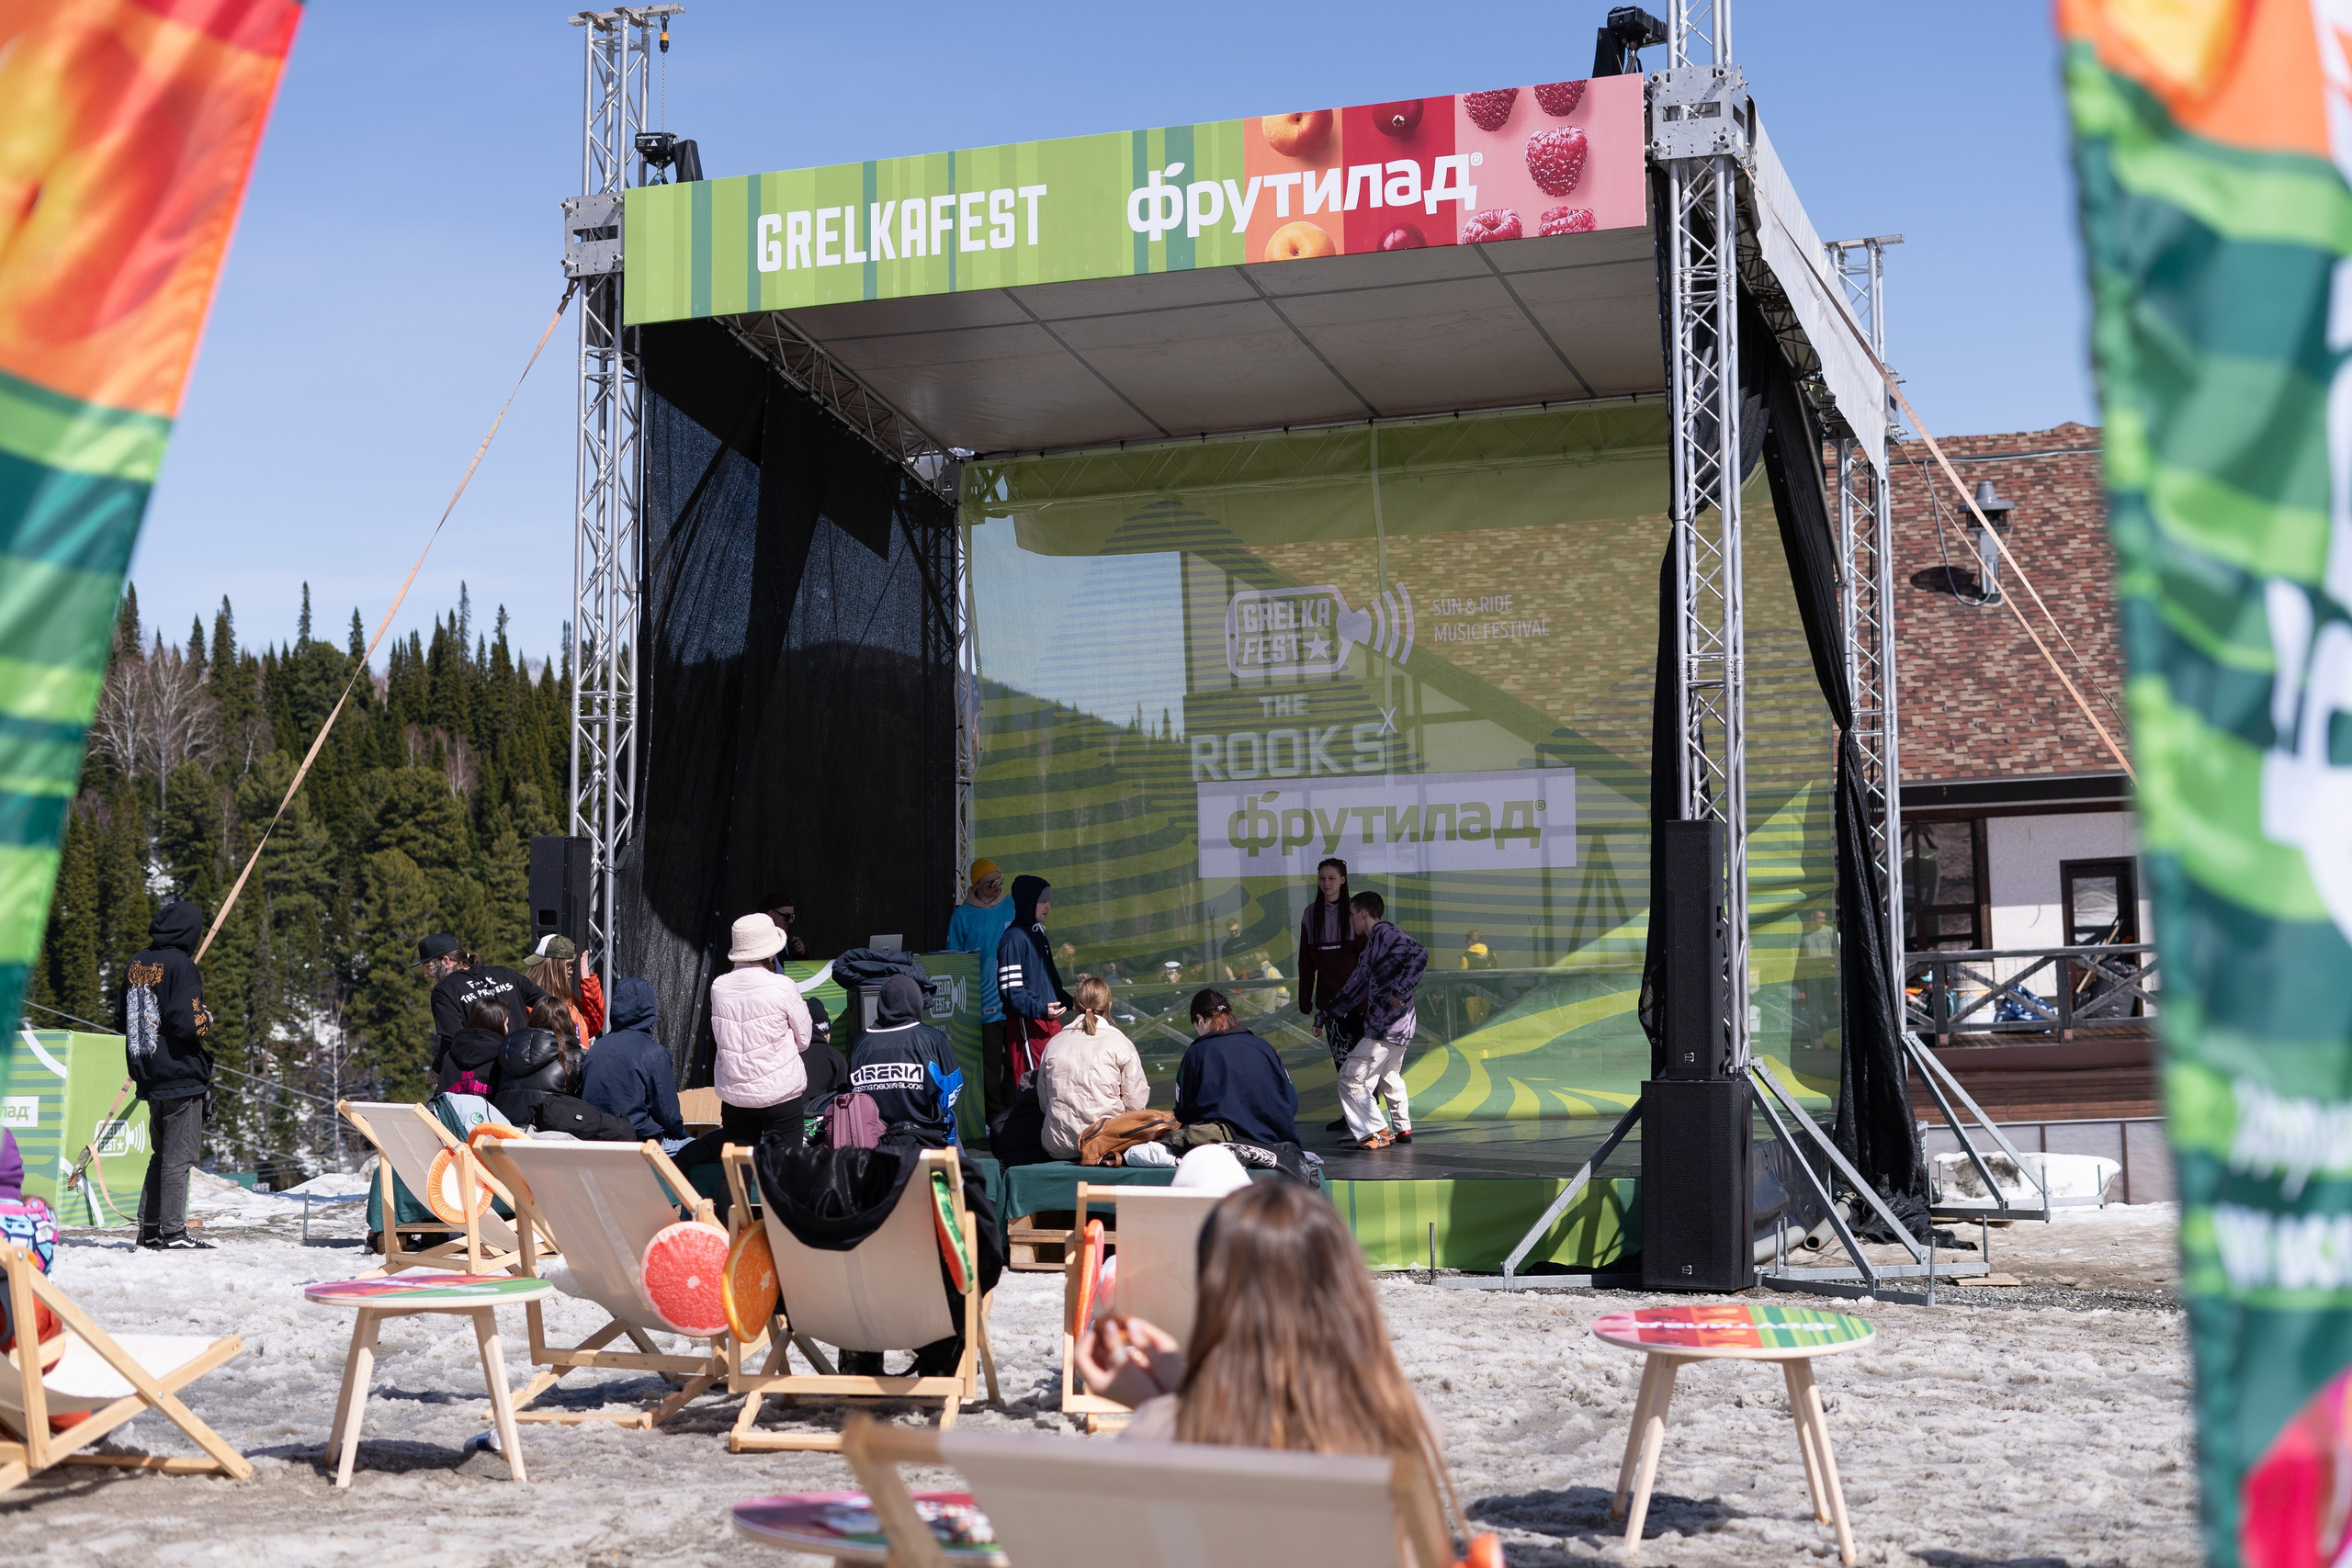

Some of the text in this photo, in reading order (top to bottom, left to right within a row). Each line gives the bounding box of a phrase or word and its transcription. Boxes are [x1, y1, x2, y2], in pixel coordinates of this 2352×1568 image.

[757, 184, 1047, 273] GRELKAFEST
[1243, 598, 1330, 633] GRELKA
[1433, 594, 1512, 615] SUN & RIDE
[1434, 619, 1550, 642] MUSIC FESTIVAL
[1242, 633, 1301, 665] FEST
[1259, 694, 1309, 717] THE
[1191, 722, 1386, 782] ROOKS
